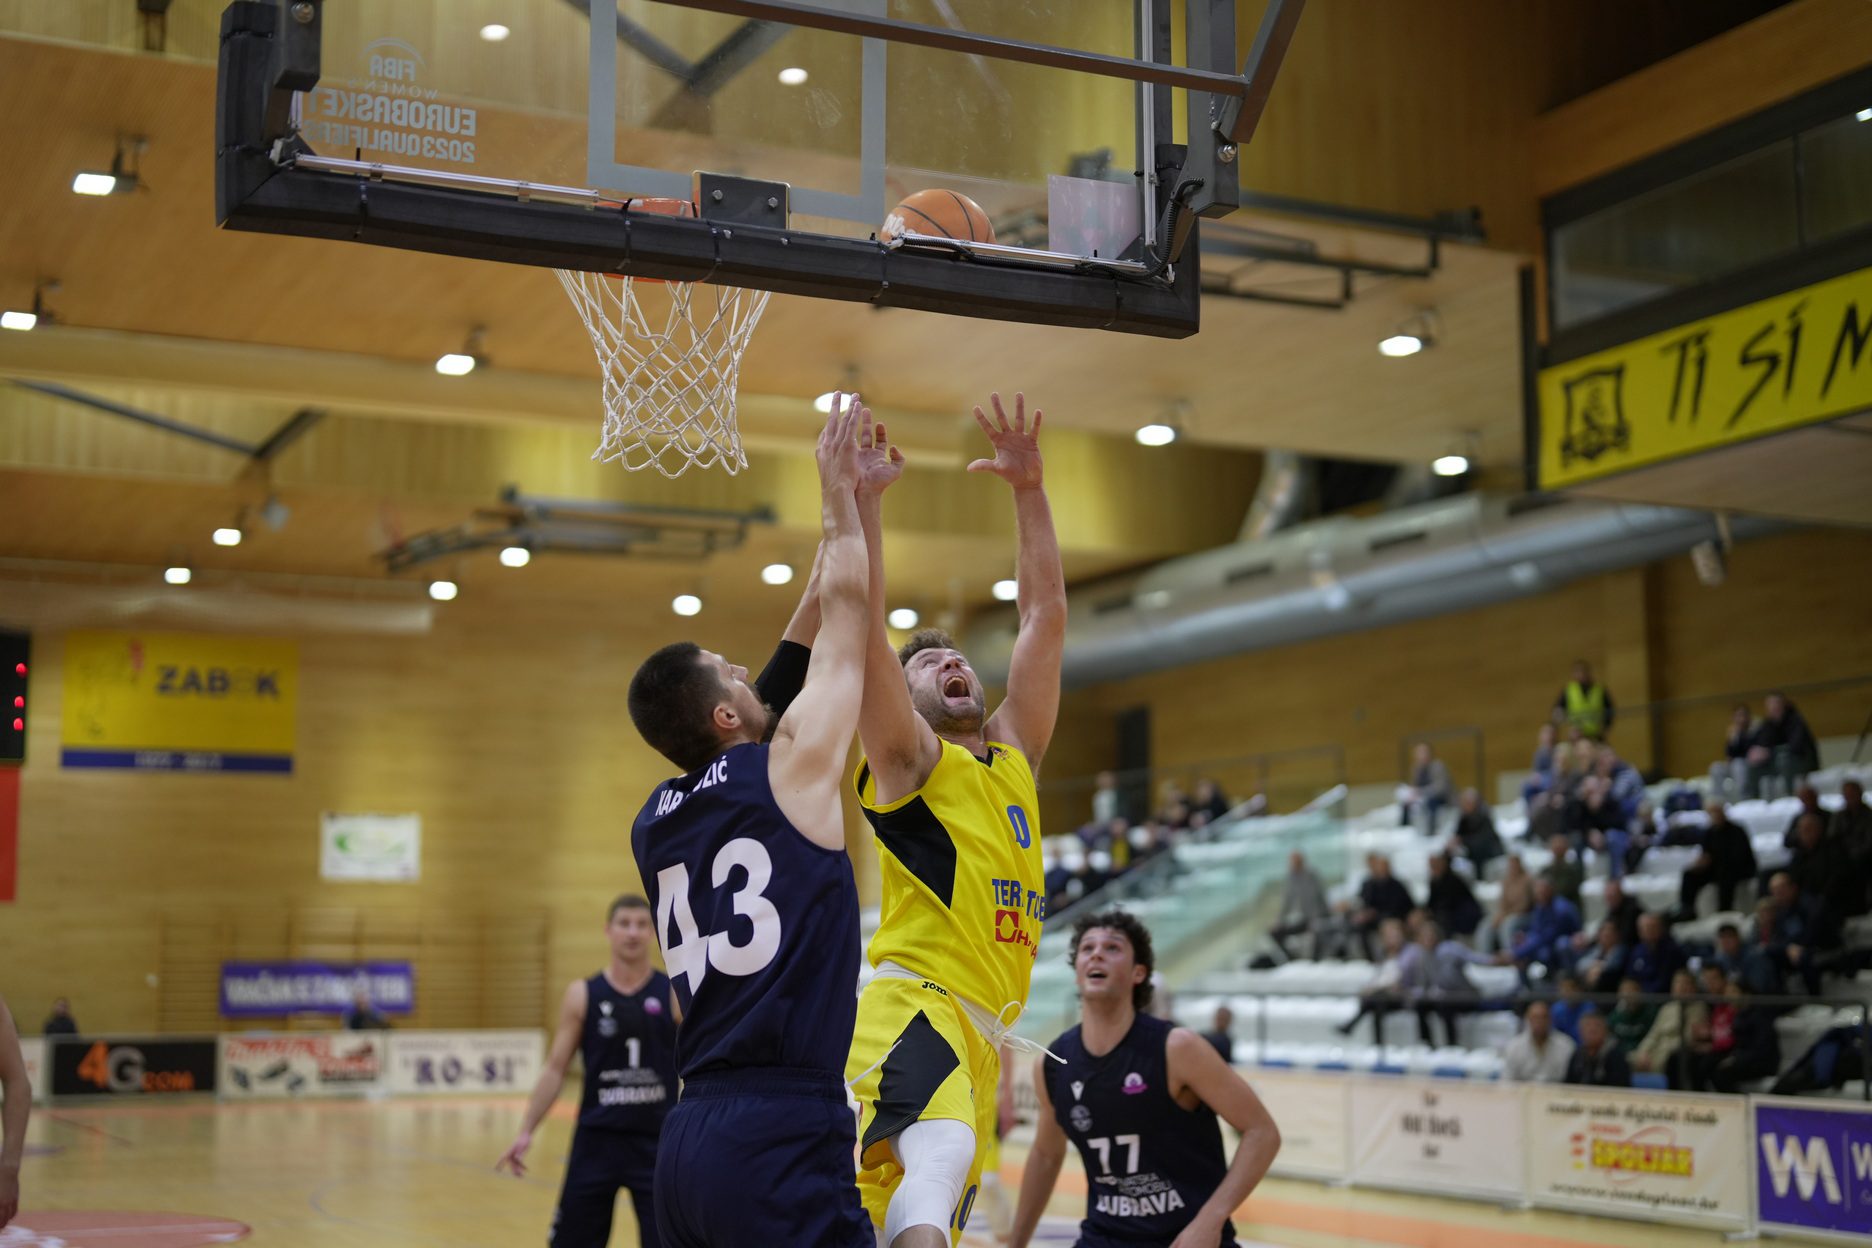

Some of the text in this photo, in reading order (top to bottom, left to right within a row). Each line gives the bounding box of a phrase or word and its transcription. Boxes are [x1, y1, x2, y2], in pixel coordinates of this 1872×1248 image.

[657, 838, 781, 996] 43
[625, 1037, 640, 1070] 1
[1086, 1134, 1140, 1174] 77
